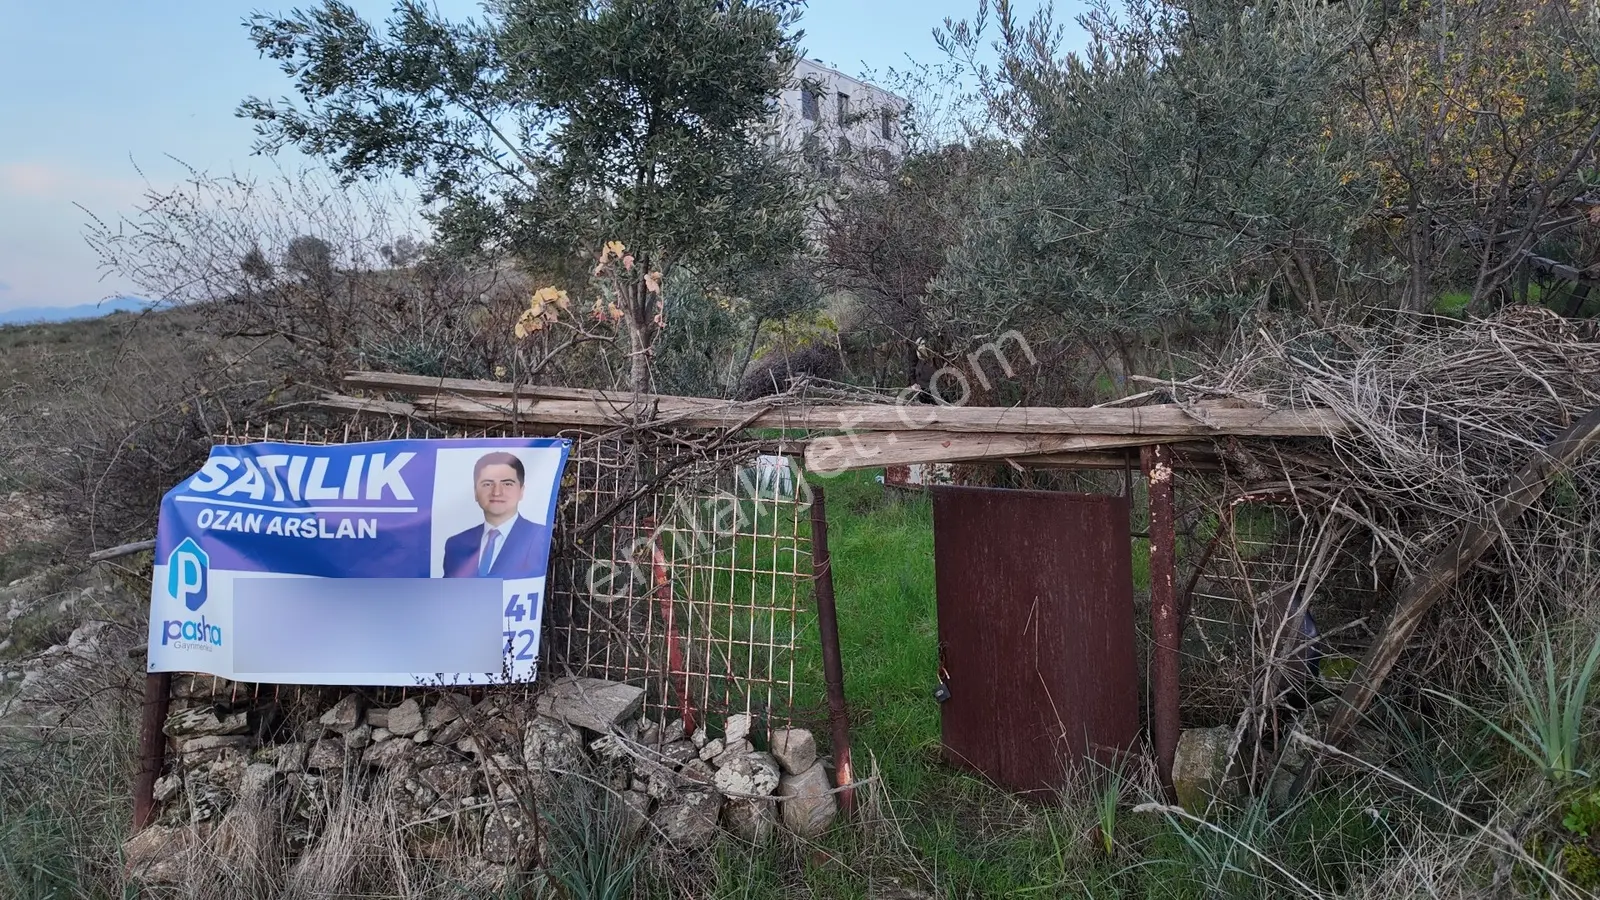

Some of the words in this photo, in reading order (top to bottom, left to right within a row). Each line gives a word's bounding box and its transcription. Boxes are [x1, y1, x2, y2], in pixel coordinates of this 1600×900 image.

[189, 452, 417, 502] SATILIK
[197, 508, 264, 534] OZAN
[266, 516, 377, 539] ARSLAN
[504, 592, 539, 622] 41
[162, 615, 222, 646] pasha
